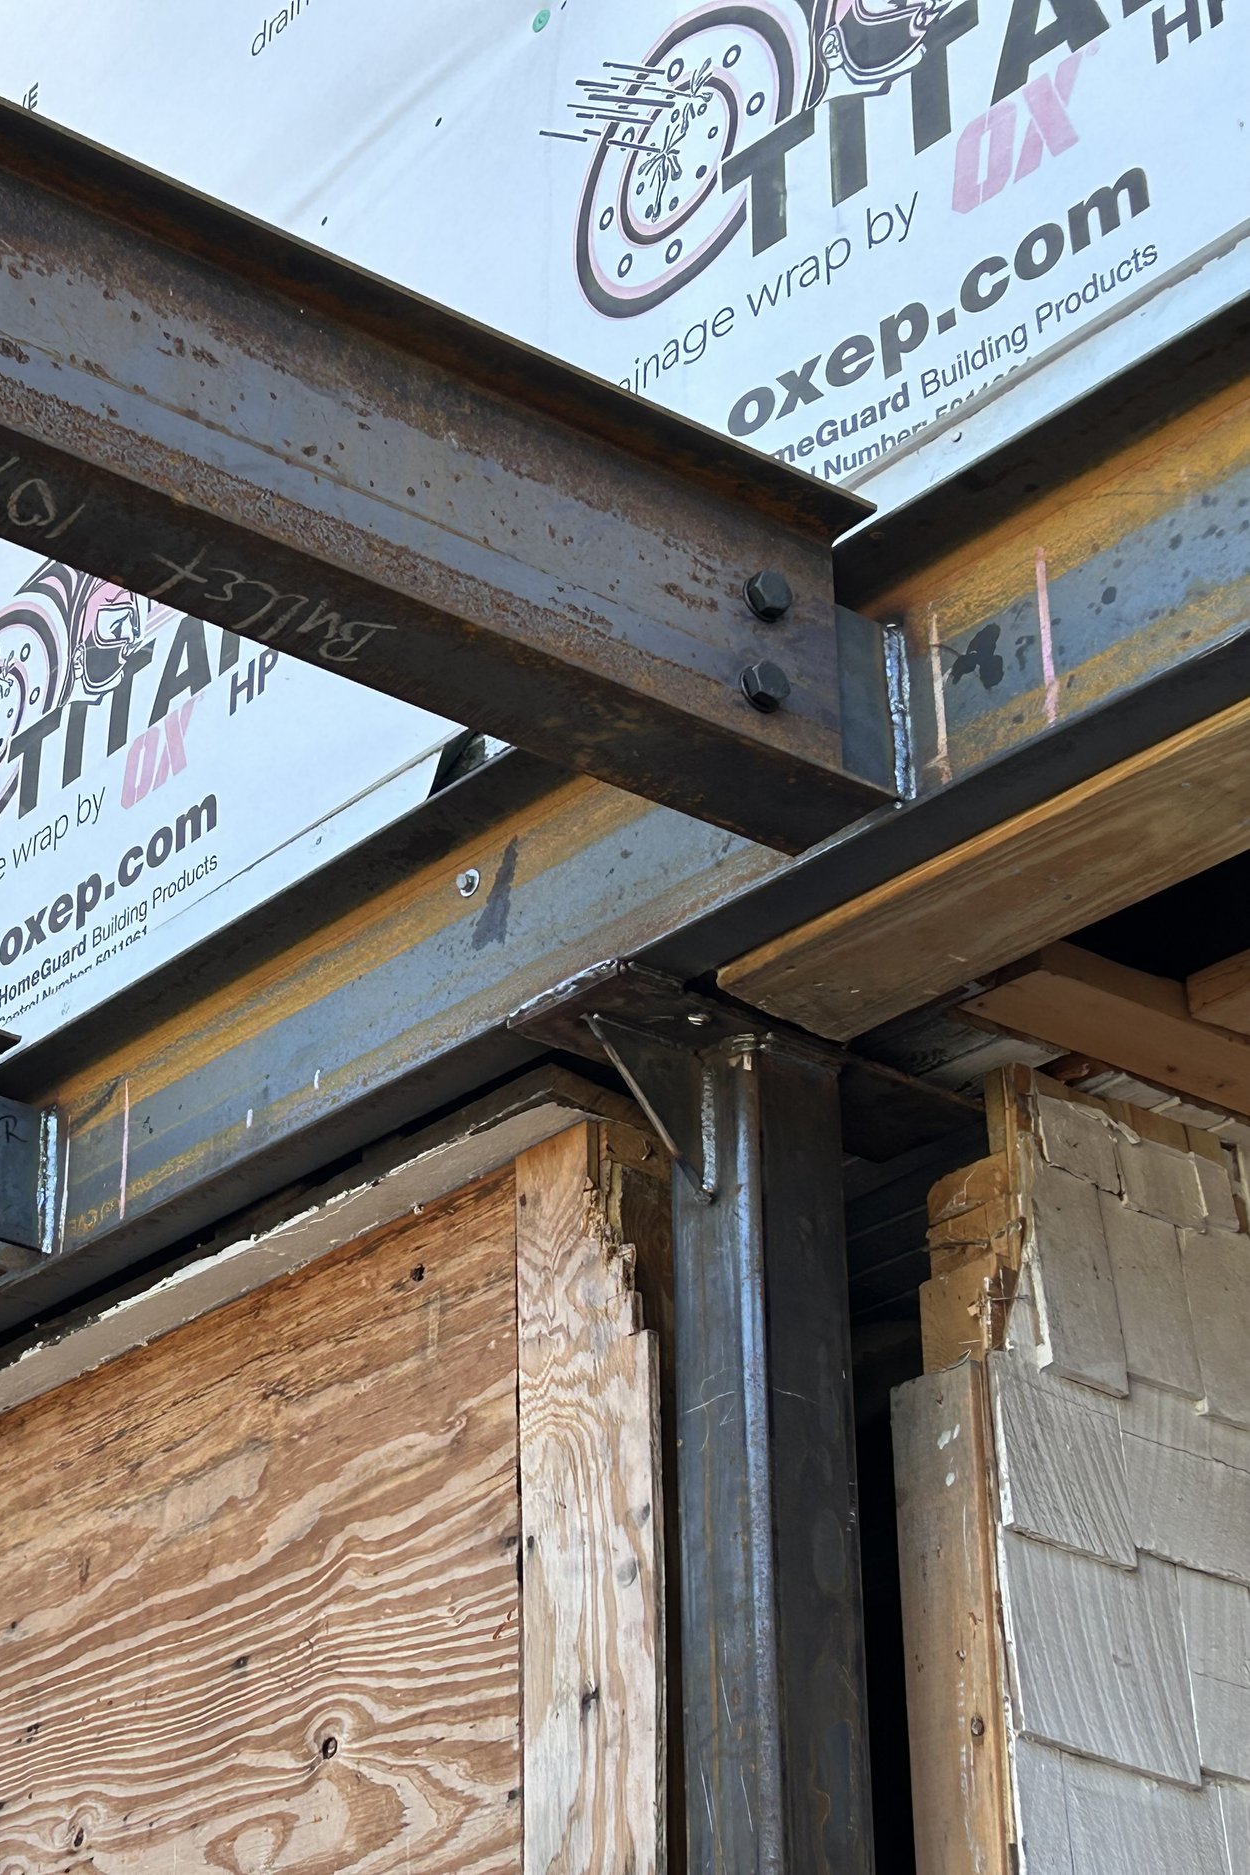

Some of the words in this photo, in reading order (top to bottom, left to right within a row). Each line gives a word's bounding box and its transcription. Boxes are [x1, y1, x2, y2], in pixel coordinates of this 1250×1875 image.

[721, 0, 1175, 258] TITA
[726, 166, 1151, 438] oxep.com
[746, 231, 852, 320] wrap
[865, 190, 919, 249] by
[769, 382, 911, 467] meGuard
[919, 322, 1028, 399] Building
[1035, 241, 1159, 334] Products
[229, 648, 279, 717] HP
[12, 813, 70, 869] wrap
[75, 786, 107, 828] by
[92, 896, 148, 949] Building
[151, 854, 219, 910] Products
